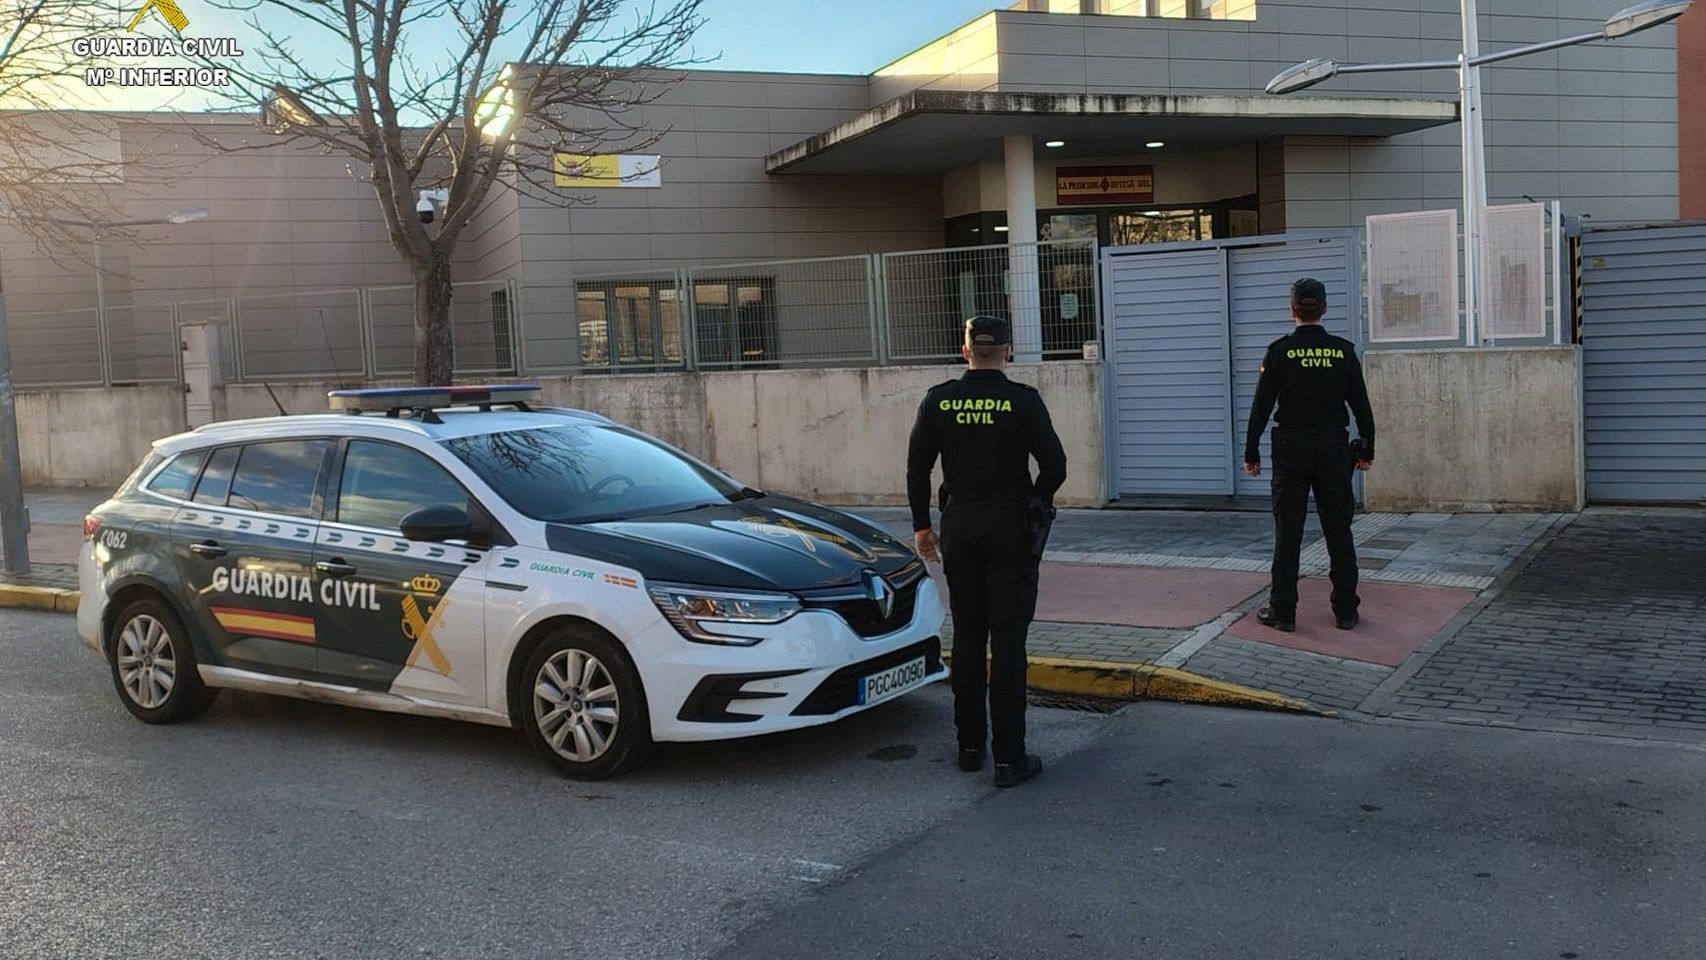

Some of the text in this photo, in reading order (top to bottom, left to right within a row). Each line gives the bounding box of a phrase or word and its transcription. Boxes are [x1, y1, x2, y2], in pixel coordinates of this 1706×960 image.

[1287, 348, 1344, 359] GUARDIA
[1301, 358, 1333, 367] CIVIL
[939, 399, 1012, 411] GUARDIA
[956, 412, 995, 424] CIVIL
[529, 562, 595, 579] GUARDIA CIVIL
[212, 566, 381, 611] GUARDIA CIVIL
[867, 660, 924, 699] PGC4009G
